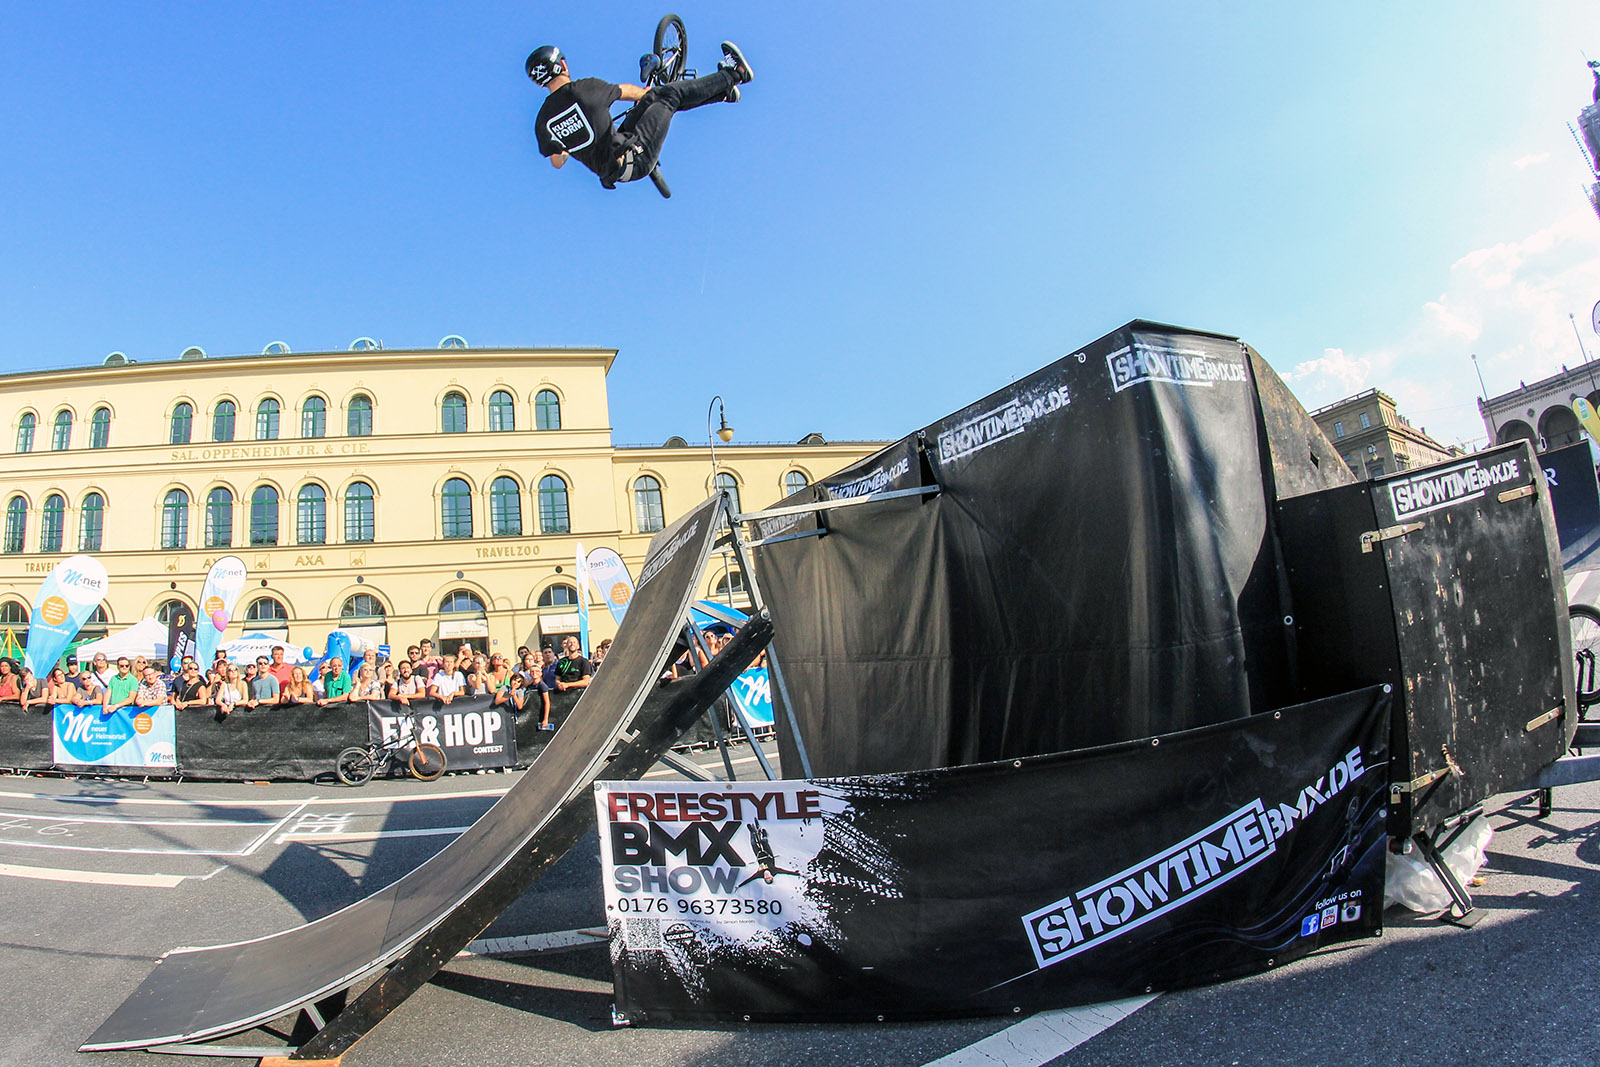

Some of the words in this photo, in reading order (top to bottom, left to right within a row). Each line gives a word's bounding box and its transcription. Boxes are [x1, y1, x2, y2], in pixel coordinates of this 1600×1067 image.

[552, 113, 579, 133] KUNST
[556, 120, 584, 139] FORM
[171, 450, 199, 461] SAL.
[202, 445, 291, 460] OPPENHEIM
[297, 444, 319, 456] JR.
[324, 444, 334, 454] &
[341, 443, 371, 454] CIE.
[295, 555, 325, 566] AXA
[476, 545, 540, 558] TRAVELZOO
[420, 715, 441, 748] &
[444, 711, 502, 747] HOP
[473, 745, 504, 754] CONTEST
[607, 791, 822, 821] FREESTYLE
[610, 821, 746, 867] BMX
[1038, 746, 1365, 953] SHOWTIMEBMX.DE
[614, 866, 741, 895] SHOW
[618, 898, 668, 913] 0176
[677, 899, 782, 915] 96373580
[1315, 896, 1337, 910] follow
[1338, 892, 1348, 901] us
[1349, 889, 1362, 898] on
